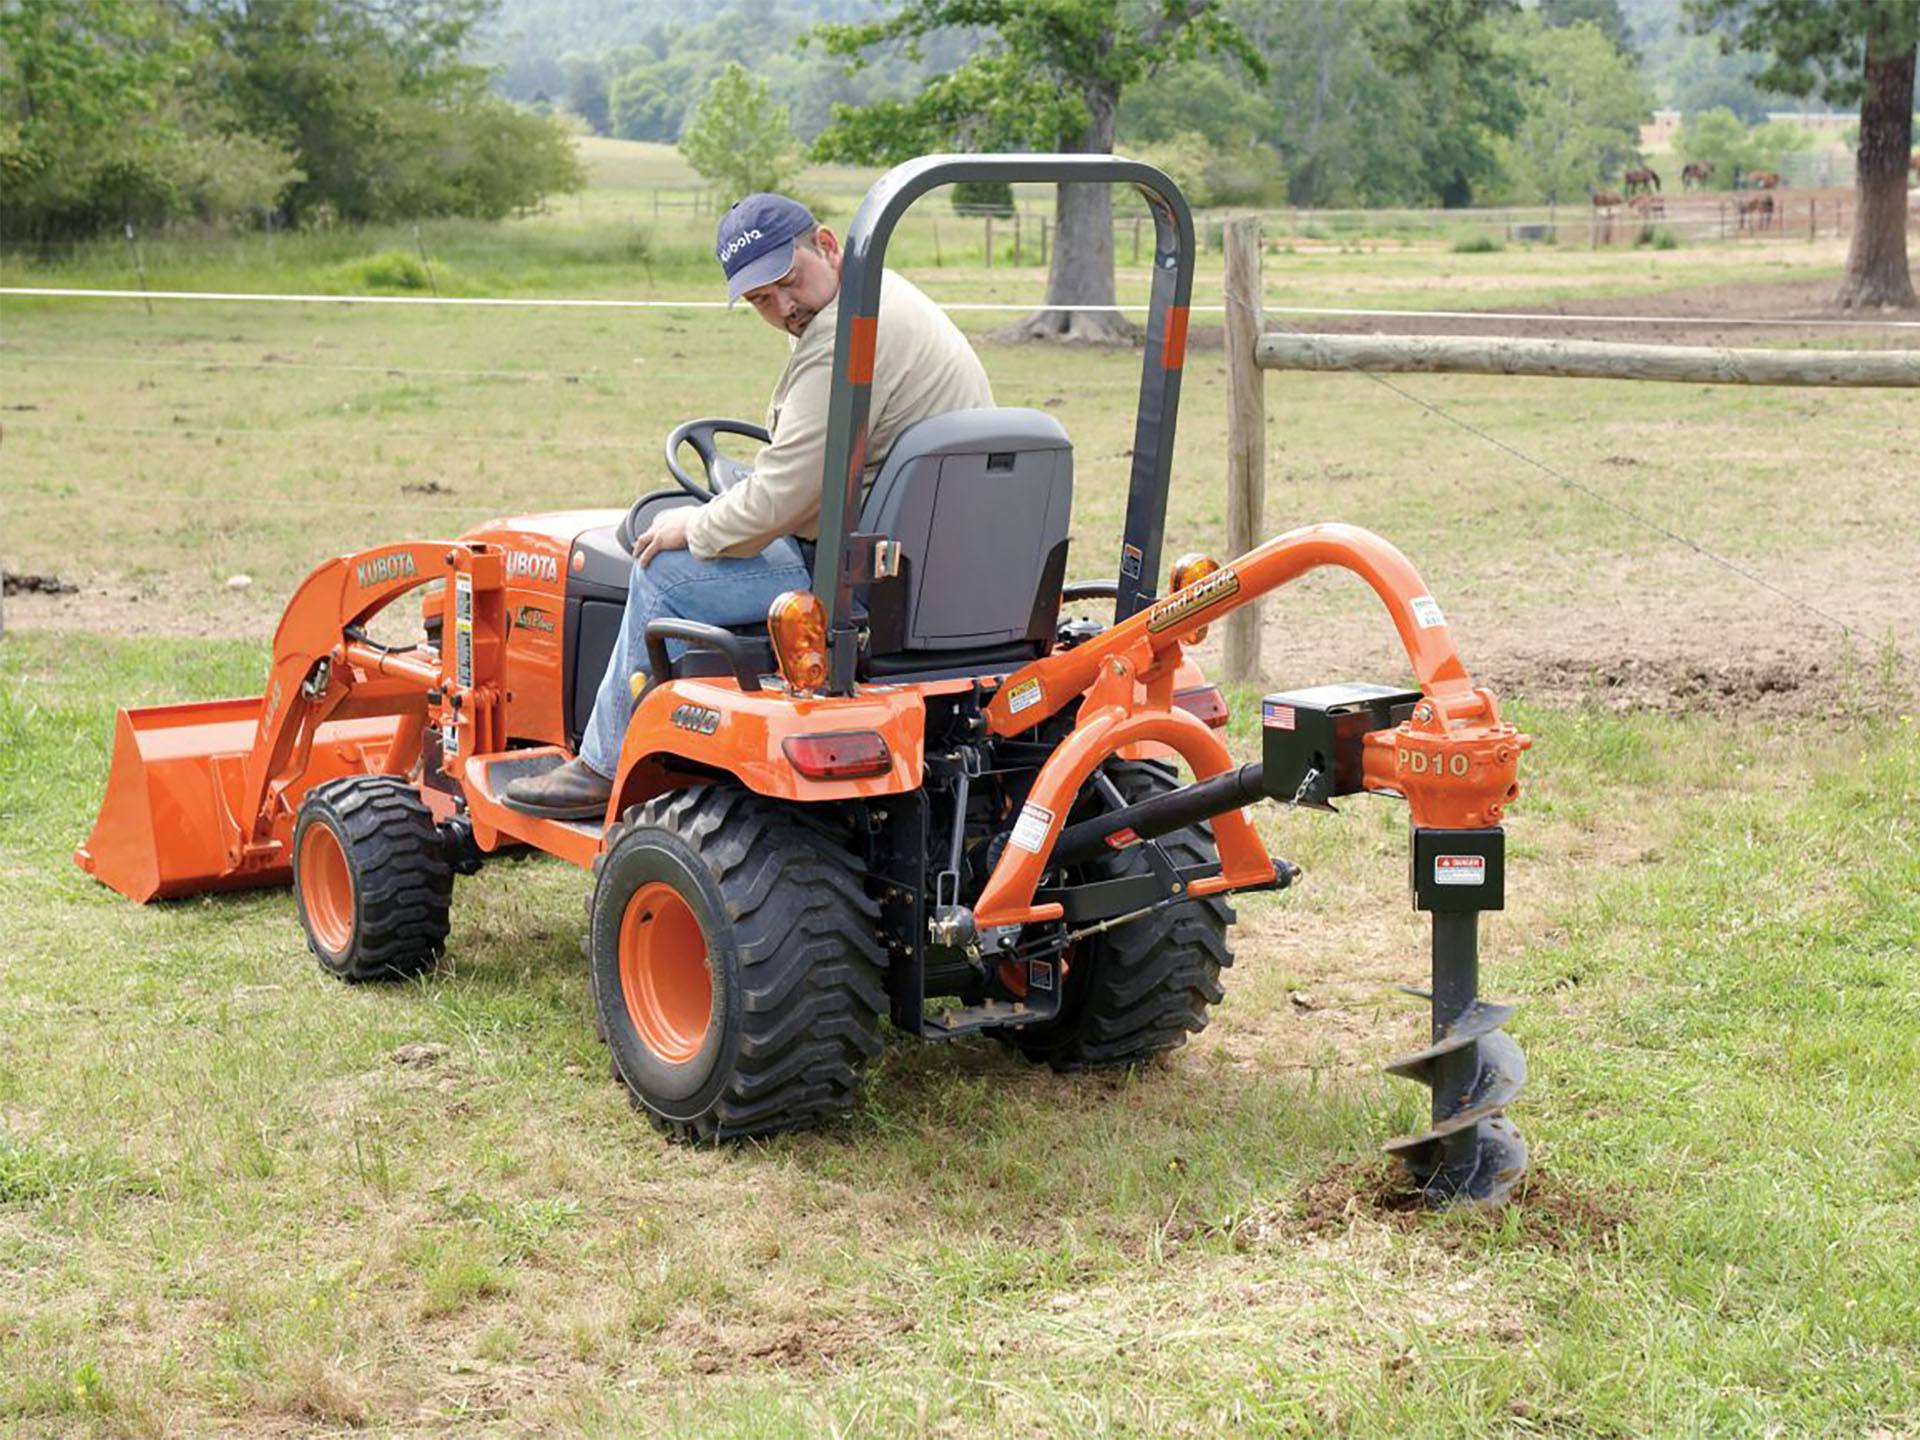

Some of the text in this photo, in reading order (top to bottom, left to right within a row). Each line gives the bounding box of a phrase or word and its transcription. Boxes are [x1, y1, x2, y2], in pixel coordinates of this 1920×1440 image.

[721, 229, 763, 262] ubota
[356, 551, 417, 585] KUBOTA
[506, 550, 558, 583] UBOTA
[671, 703, 722, 736] 4WD
[1398, 748, 1469, 776] PD10
